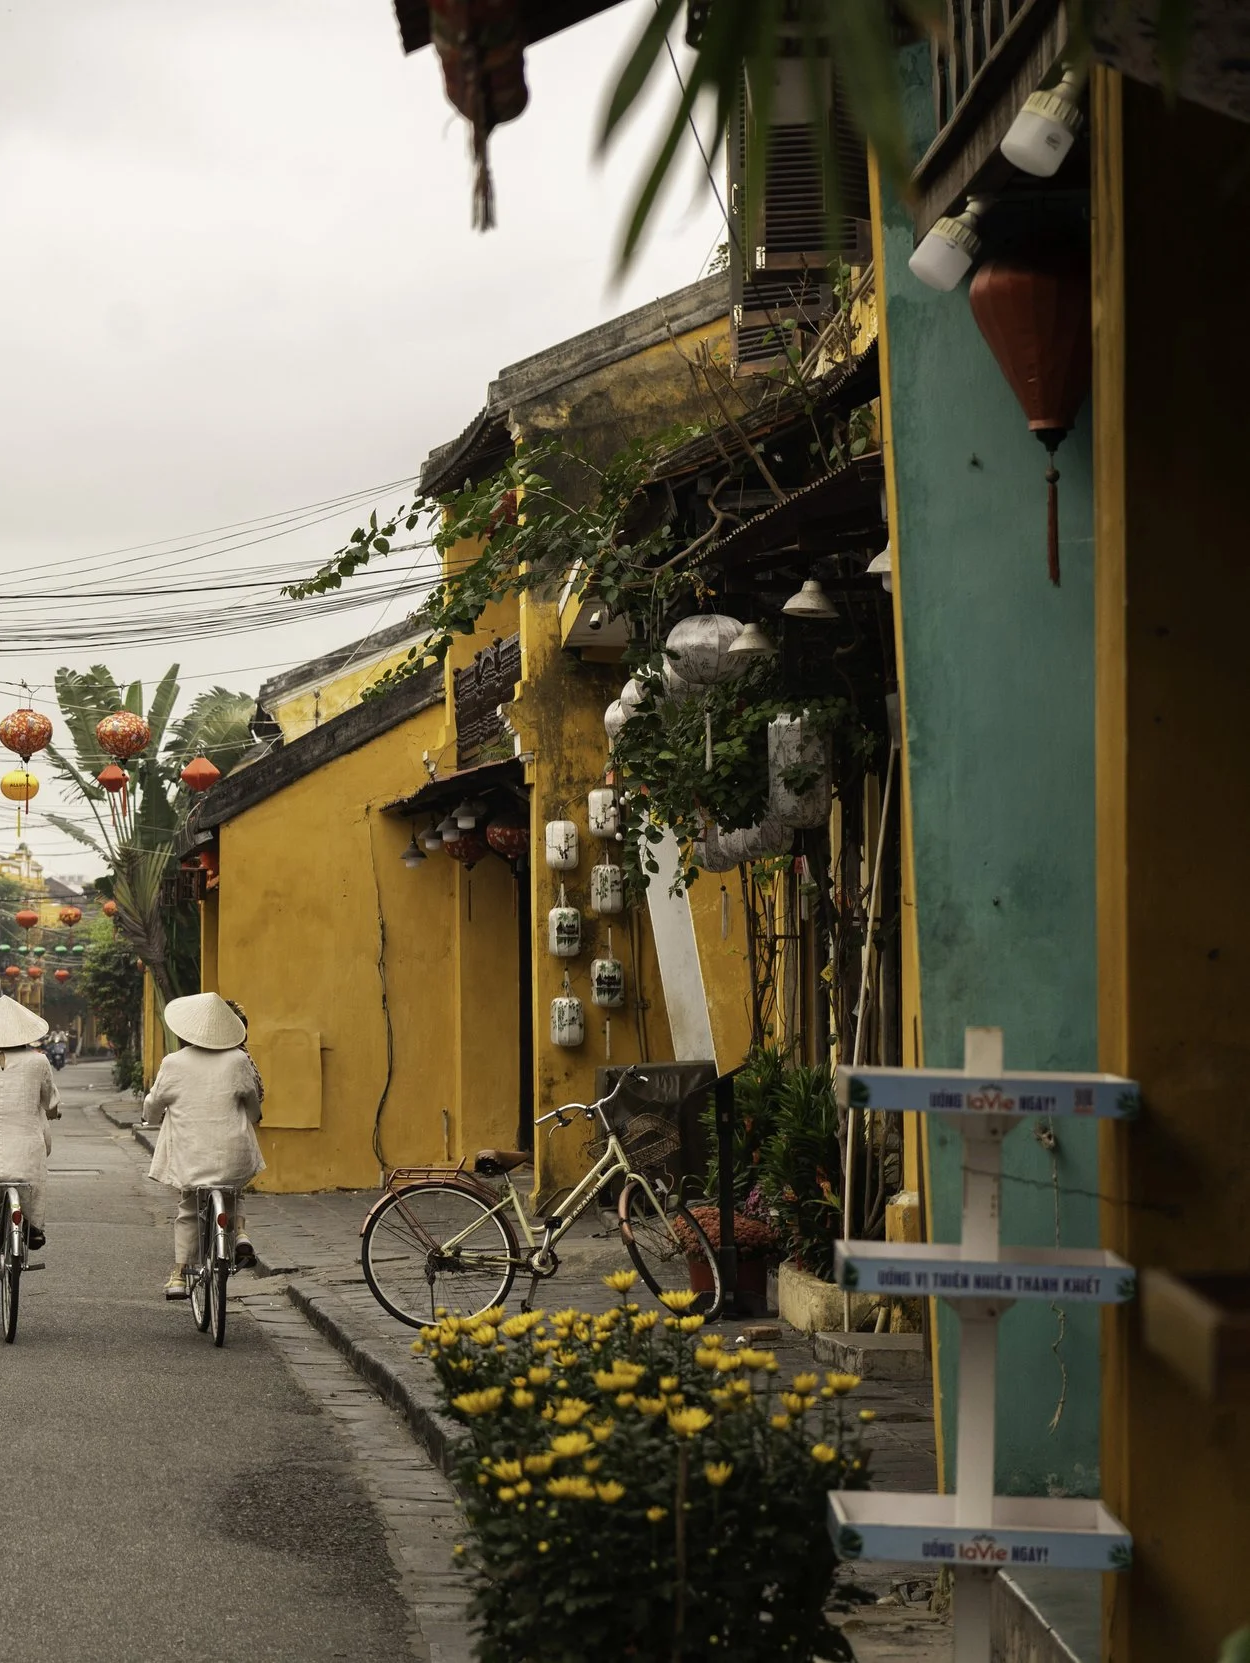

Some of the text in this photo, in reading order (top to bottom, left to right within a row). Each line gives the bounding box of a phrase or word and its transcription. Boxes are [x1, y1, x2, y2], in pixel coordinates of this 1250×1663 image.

[572, 1187, 598, 1217] ASAMA
[1016, 1275, 1059, 1293] THANH
[1011, 1544, 1050, 1563] NGAY!
